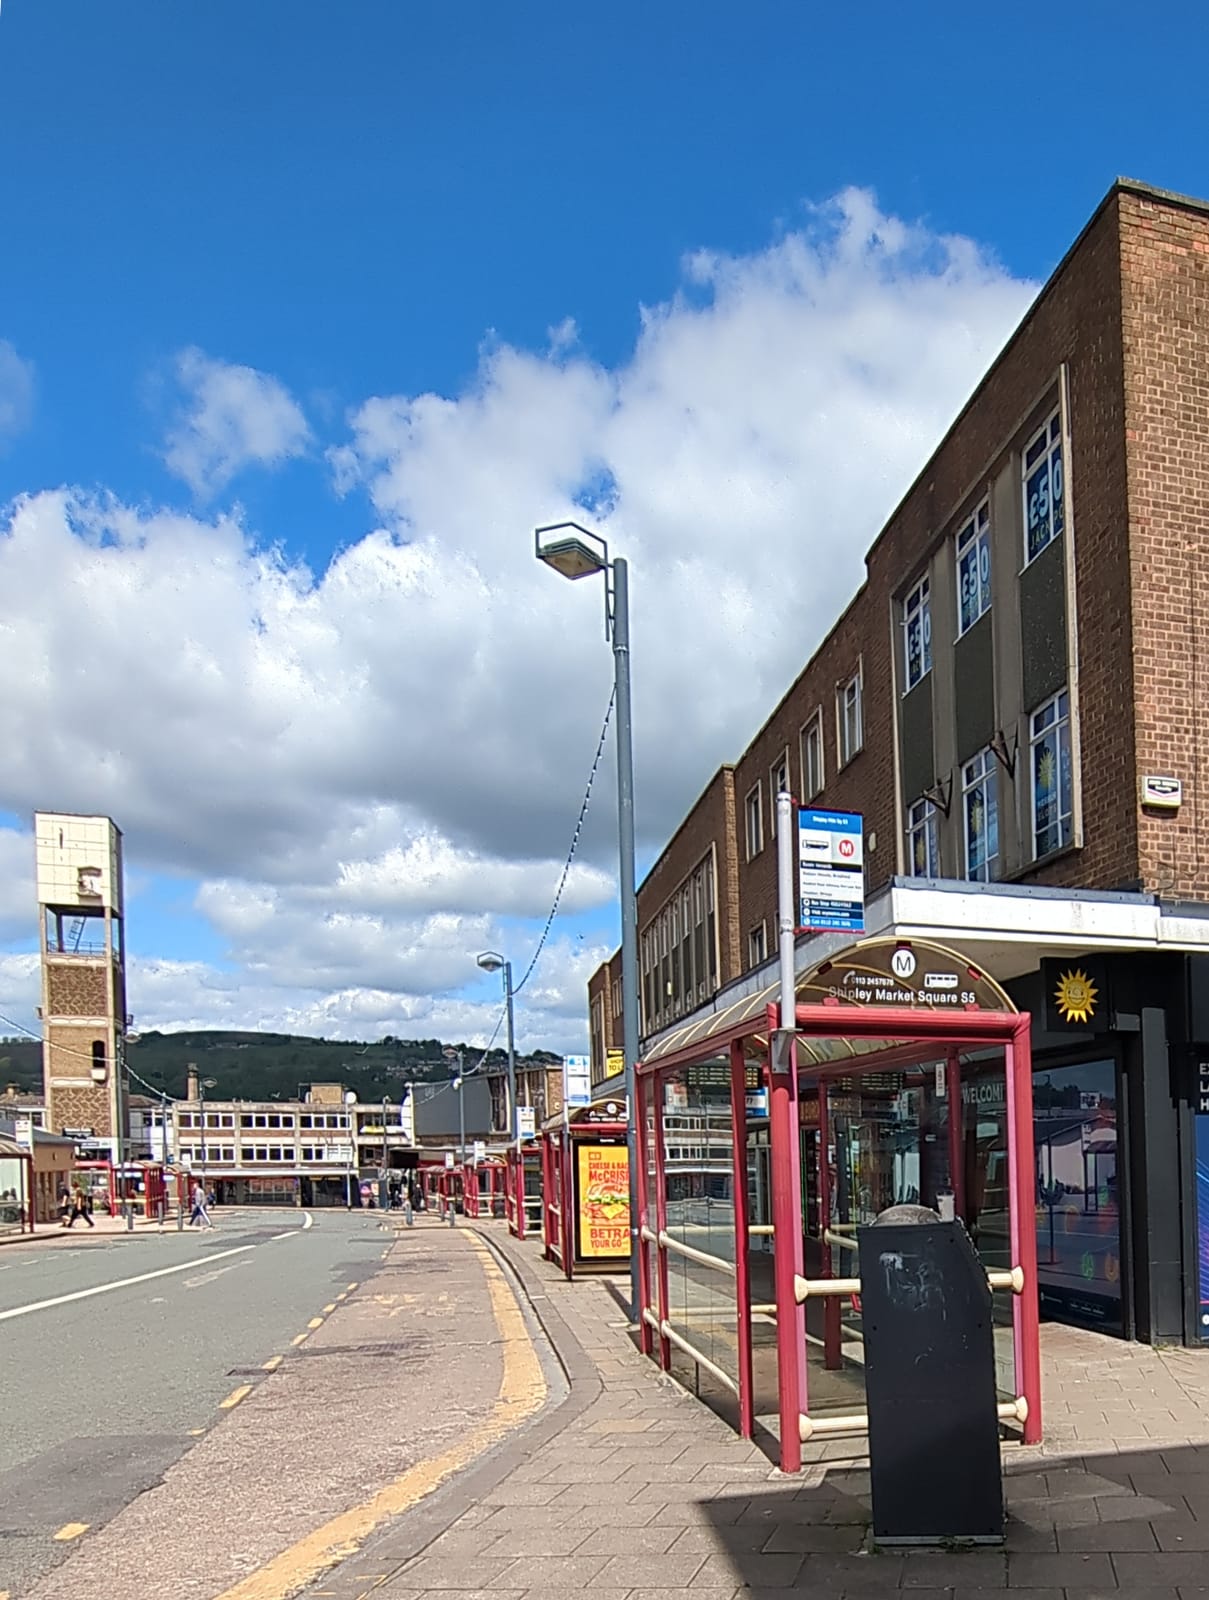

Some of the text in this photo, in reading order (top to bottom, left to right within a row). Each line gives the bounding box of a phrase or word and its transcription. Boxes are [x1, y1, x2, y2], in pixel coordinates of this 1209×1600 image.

[1030, 459, 1063, 529] £50
[962, 545, 989, 605] £50
[896, 956, 912, 972] M
[828, 986, 976, 1006] Shipley Market Square S5
[1200, 1063, 1209, 1075] E
[1200, 1081, 1209, 1093] L
[590, 1240, 610, 1249] YOUR
